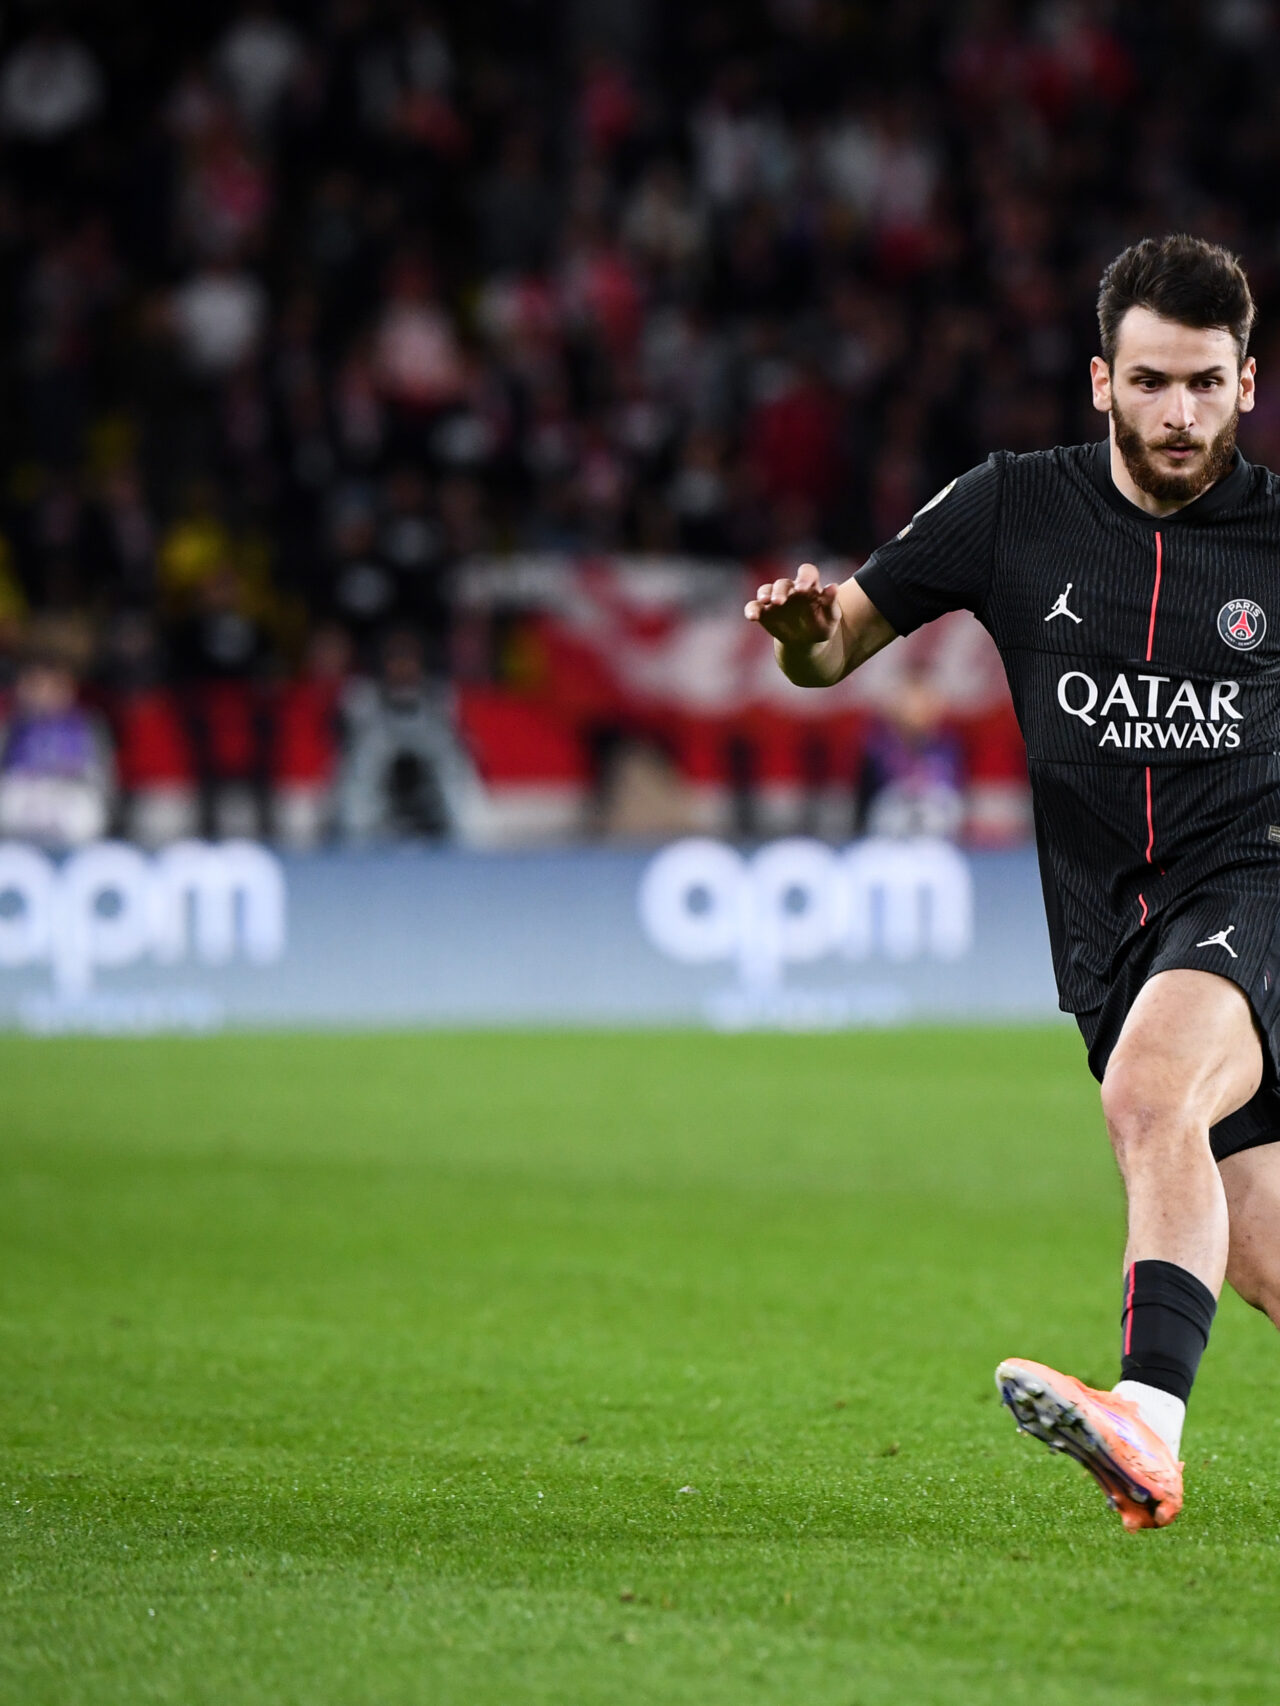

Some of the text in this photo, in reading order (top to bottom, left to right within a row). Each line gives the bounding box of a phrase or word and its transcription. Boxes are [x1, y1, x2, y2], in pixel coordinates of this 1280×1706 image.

[1228, 602, 1261, 617] PARIS
[1057, 671, 1244, 726] QATAR
[1098, 721, 1241, 749] AIRWAYS
[640, 837, 974, 992] apm
